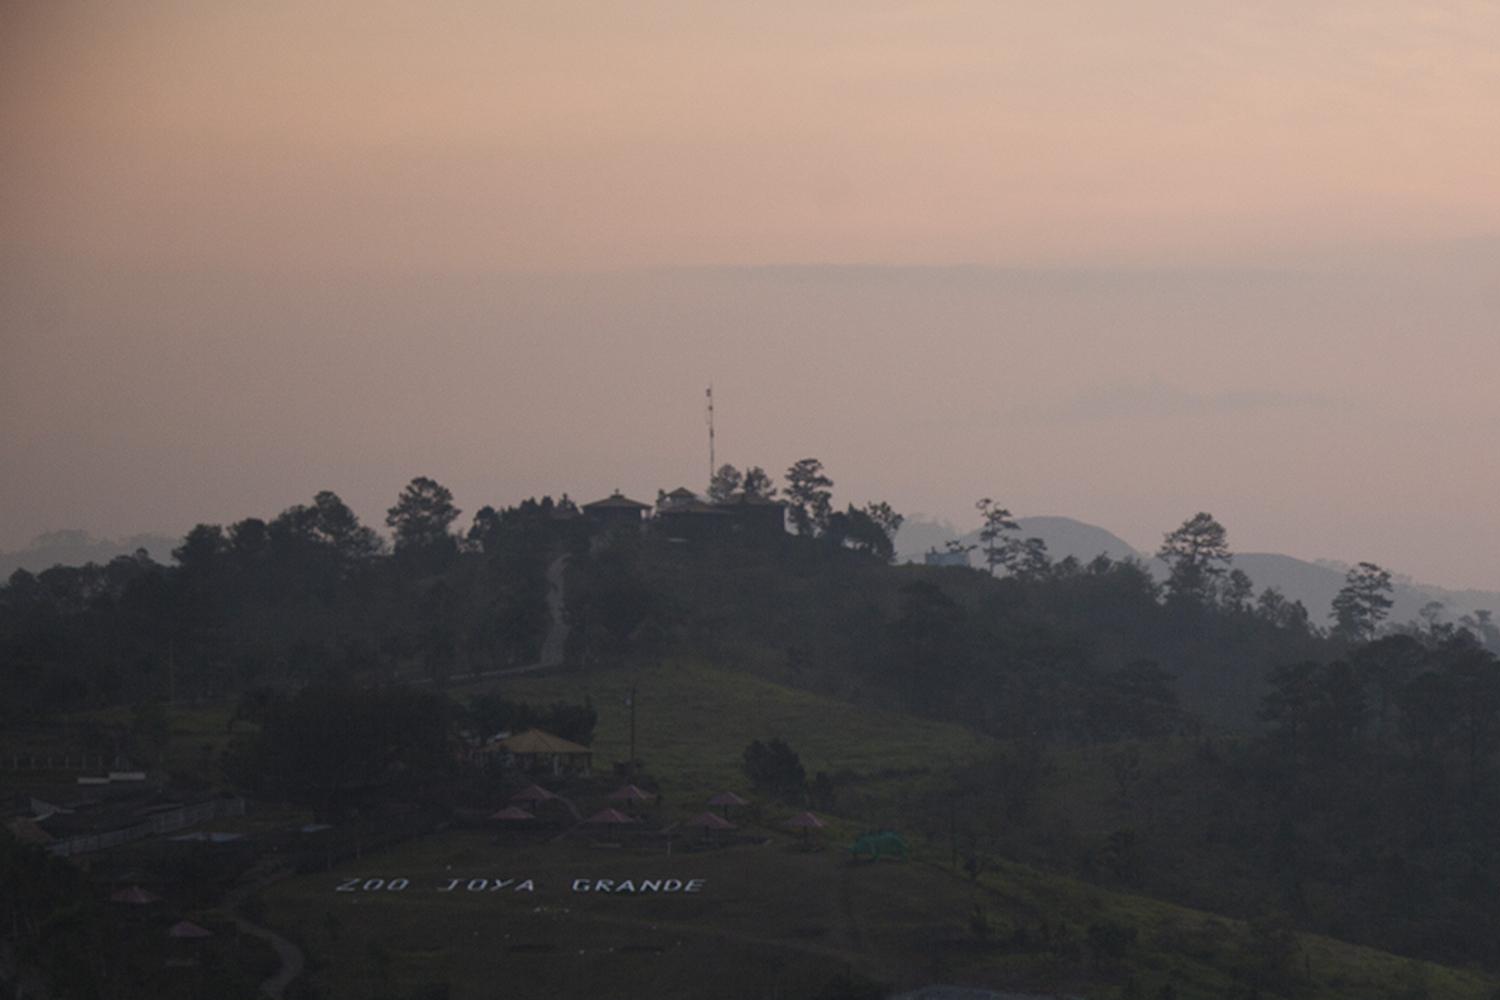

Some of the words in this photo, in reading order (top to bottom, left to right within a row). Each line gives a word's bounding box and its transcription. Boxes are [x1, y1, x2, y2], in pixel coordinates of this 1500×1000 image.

[336, 878, 410, 892] ZOO
[437, 878, 536, 892] JOYA
[572, 879, 705, 892] GRANDE
